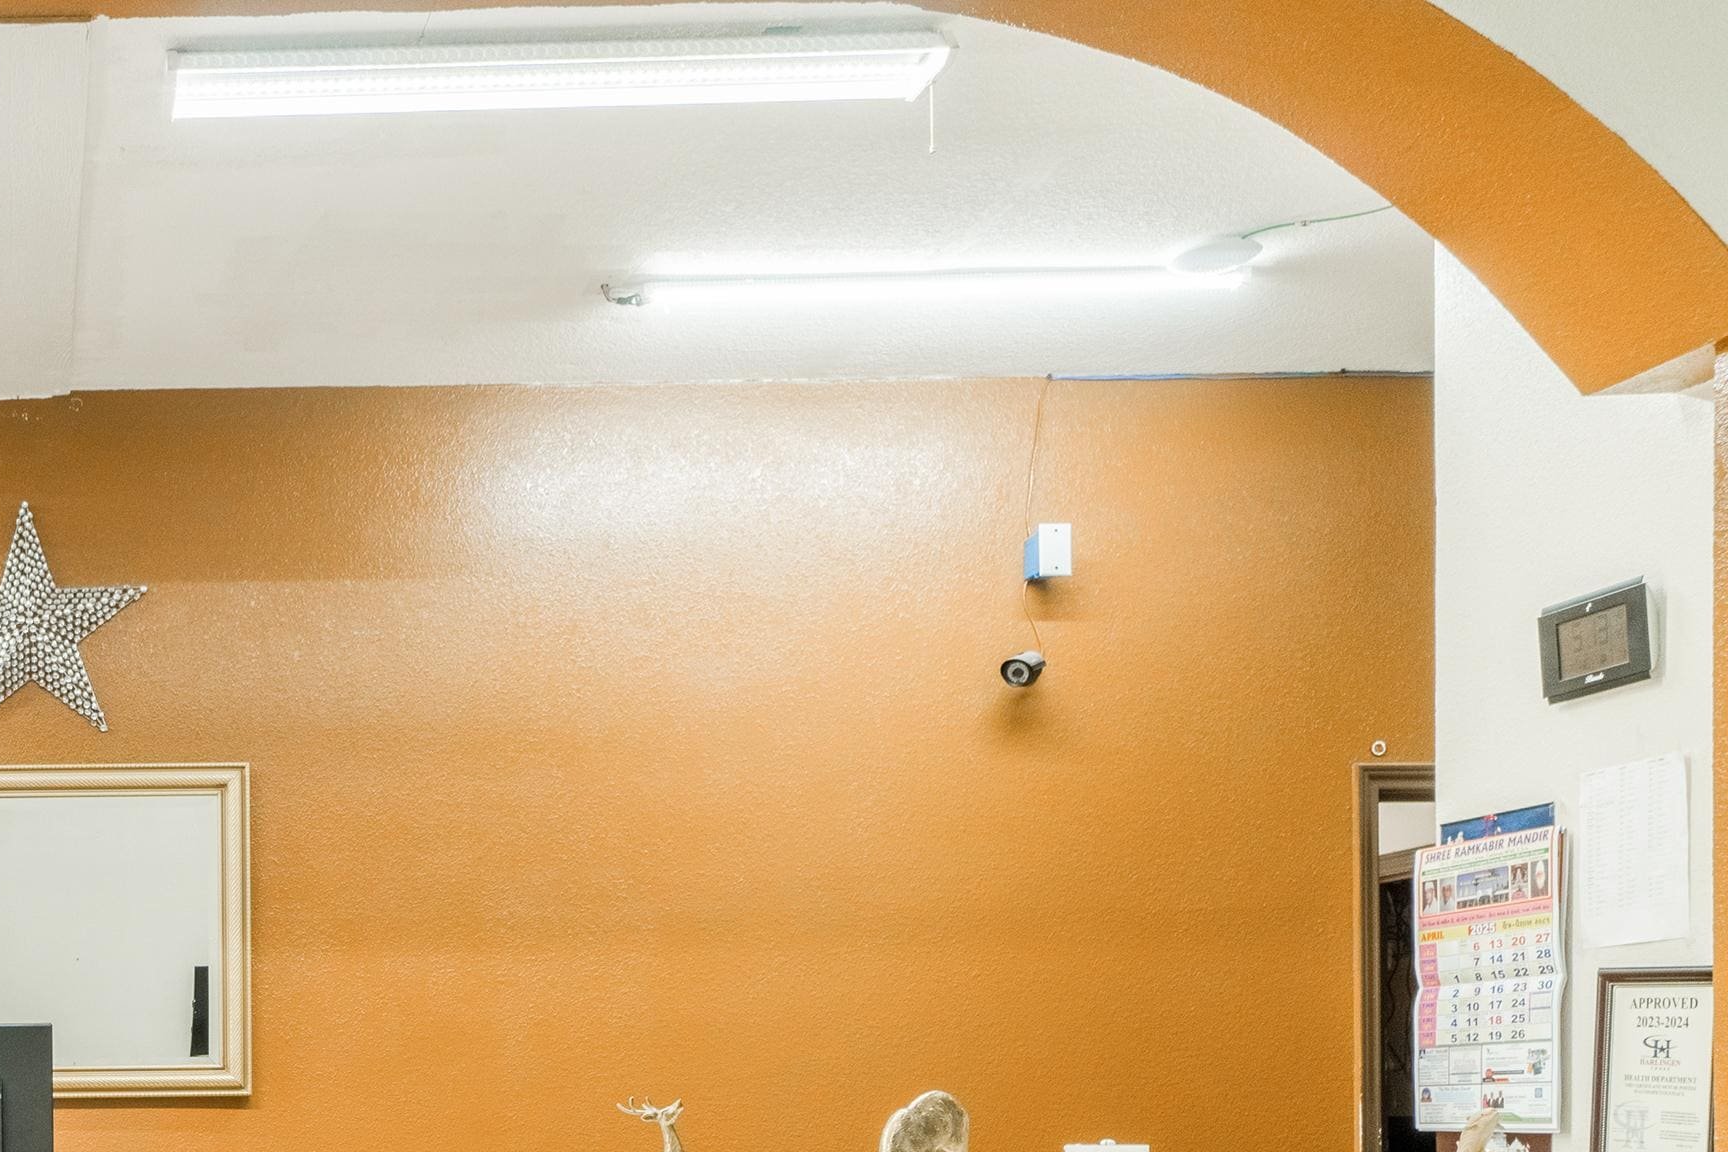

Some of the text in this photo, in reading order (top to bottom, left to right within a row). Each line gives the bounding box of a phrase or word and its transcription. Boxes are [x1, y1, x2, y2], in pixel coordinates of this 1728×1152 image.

[1425, 851, 1452, 864] SHREE
[1454, 840, 1505, 860] RAMKABIR
[1507, 830, 1550, 848] MANDIR
[1420, 931, 1445, 941] APRIL
[1468, 923, 1497, 937] 2025
[1473, 933, 1550, 951] 6 13 20 27
[1473, 949, 1551, 966] 7 14 21 28
[1454, 965, 1554, 983] 1 8 15 22 29
[1453, 980, 1552, 998] 2 9 16 23 30
[1451, 998, 1525, 1013] 3 10 17 24
[1631, 997, 1698, 1009] APPROVED
[1451, 1013, 1525, 1028] 4 11 18 25
[1636, 1016, 1689, 1029] 2023-2024
[1452, 1029, 1525, 1043] 5 12 19 26
[1640, 1058, 1681, 1067] HARLINGEN
[1624, 1074, 1697, 1085] HEALTH DEPARTMENT
